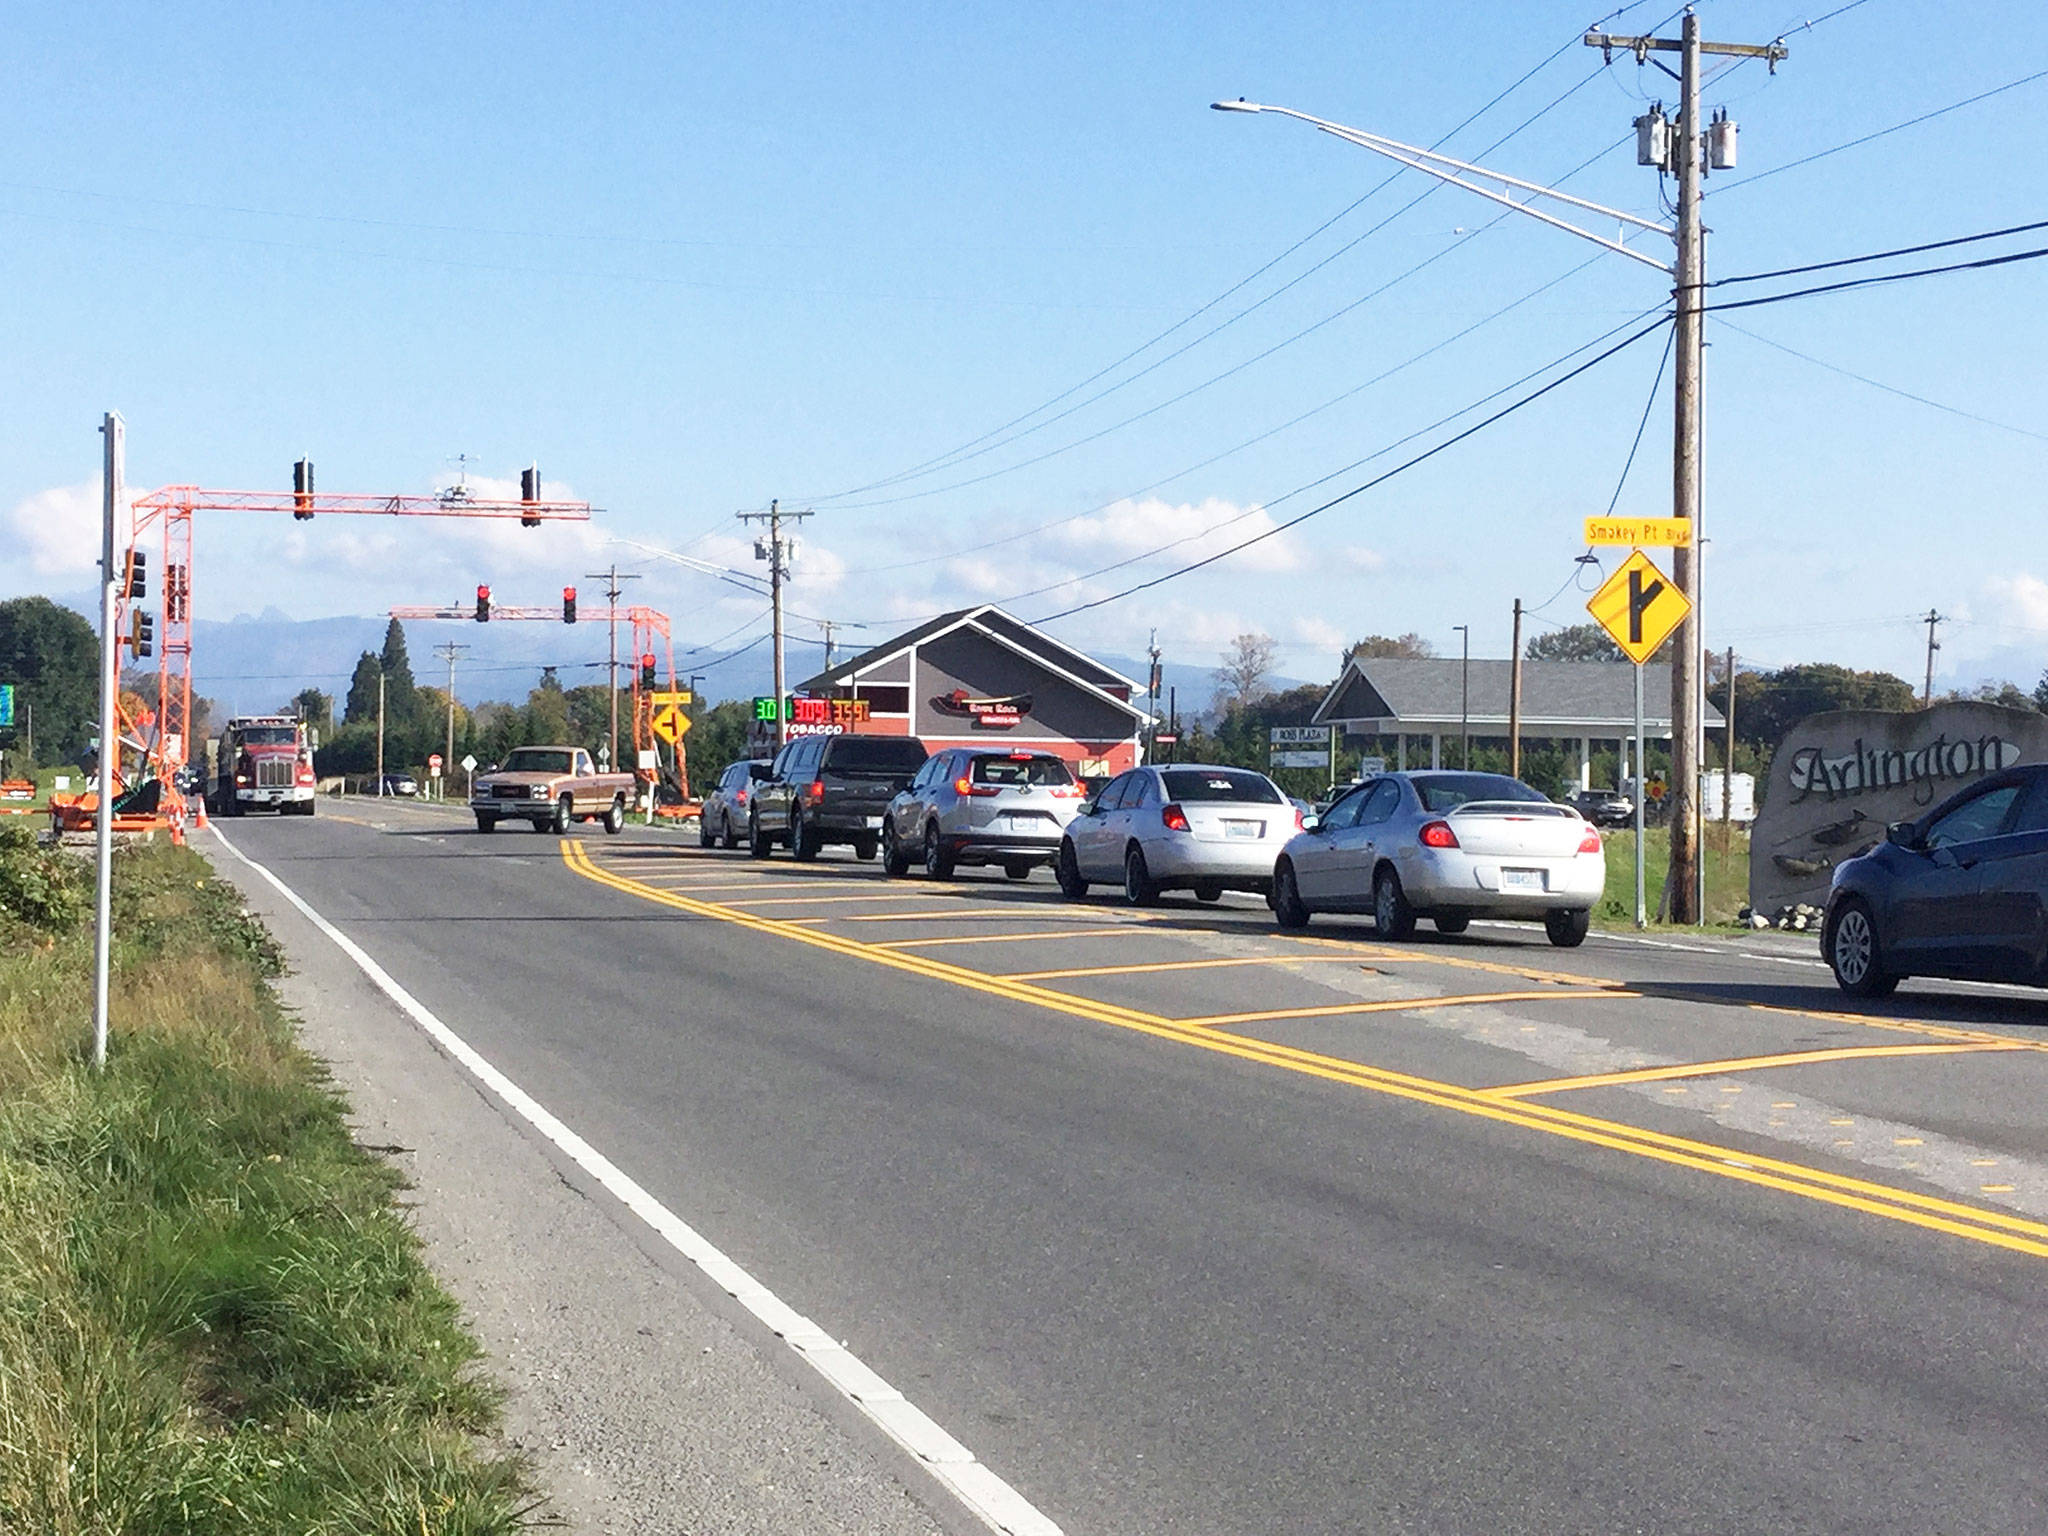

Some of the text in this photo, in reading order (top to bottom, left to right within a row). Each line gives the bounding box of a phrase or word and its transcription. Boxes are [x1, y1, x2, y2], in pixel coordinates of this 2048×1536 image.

[1590, 523, 1636, 543] Smokey
[1644, 525, 1657, 540] Pt
[784, 724, 843, 735] TOBACCO
[1790, 733, 2004, 806] Arlington
